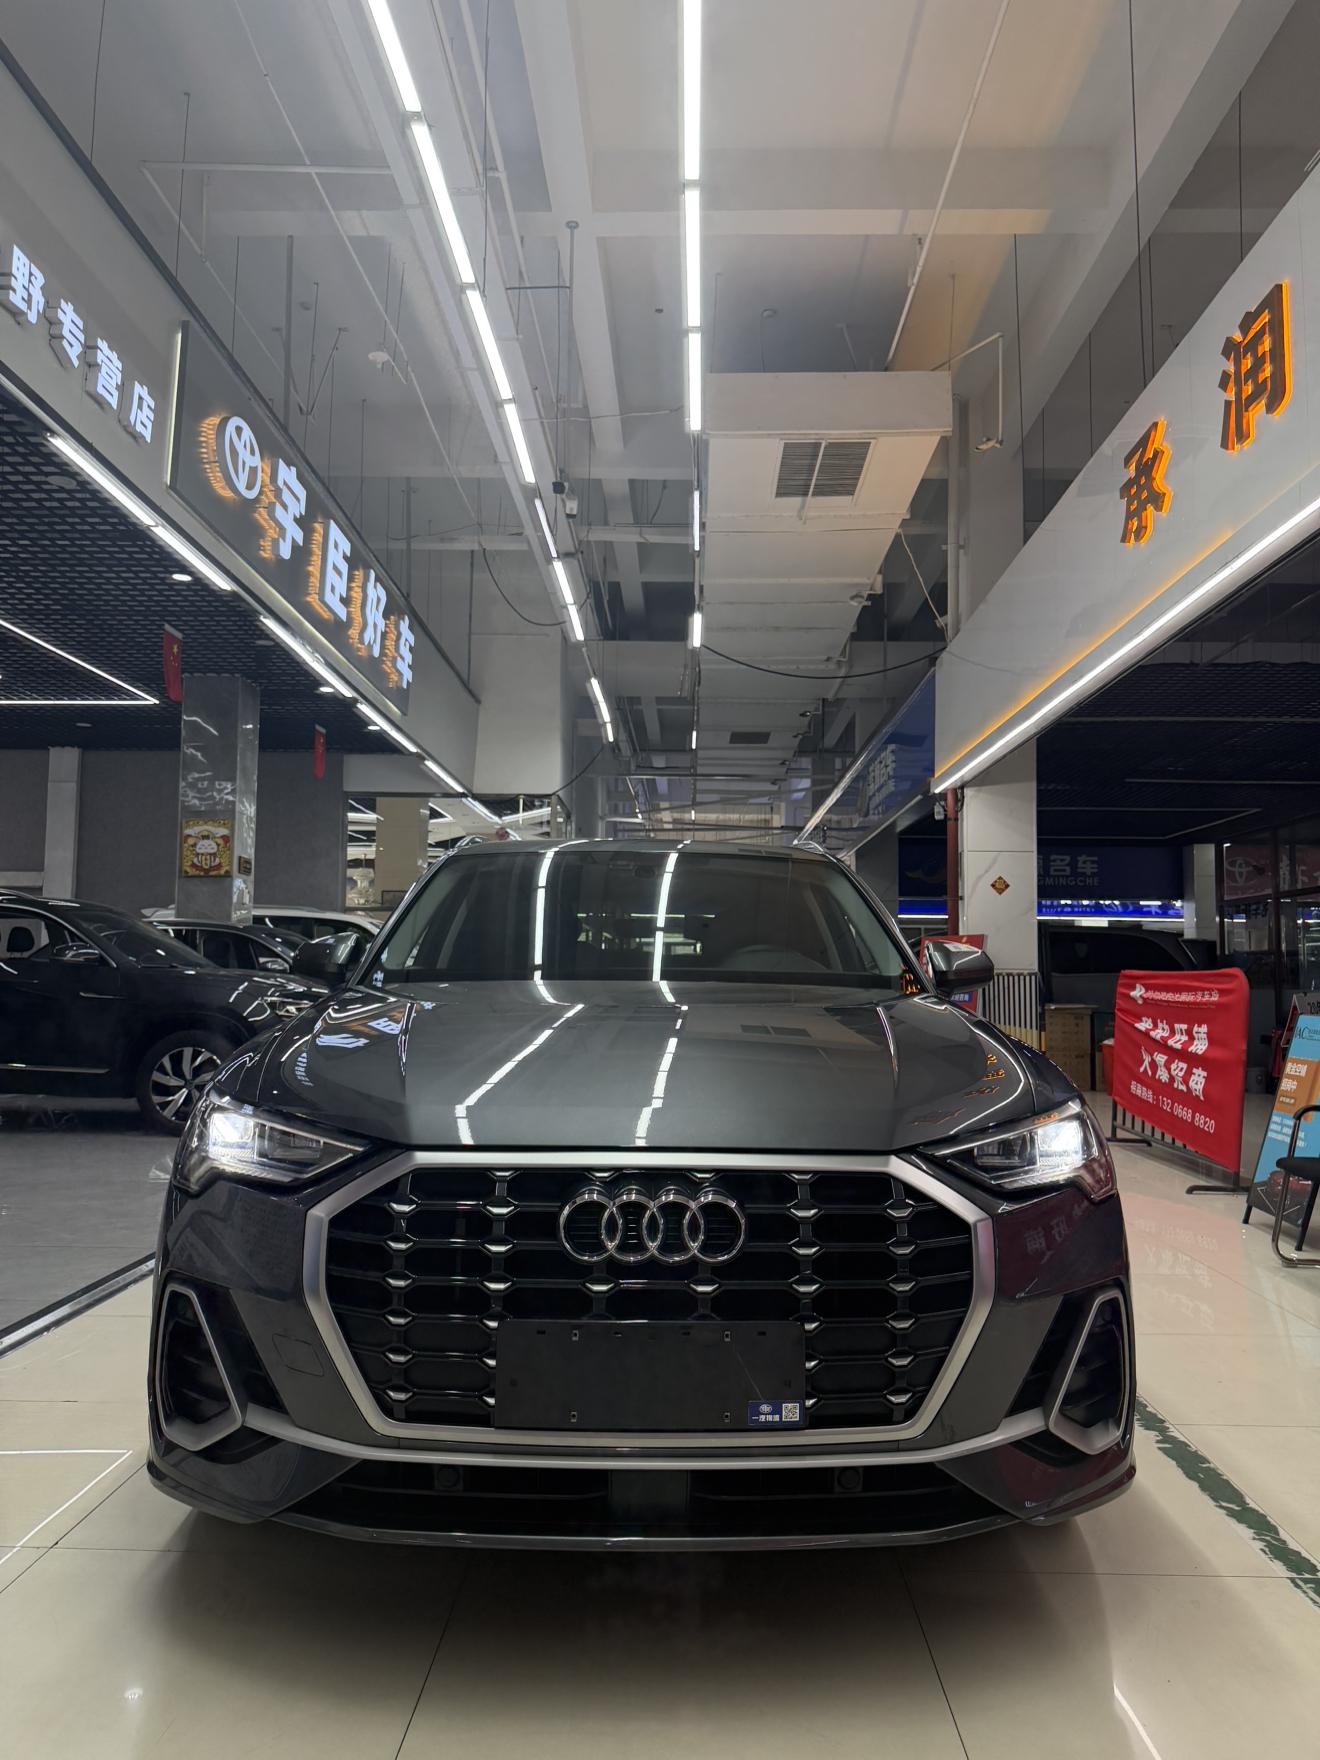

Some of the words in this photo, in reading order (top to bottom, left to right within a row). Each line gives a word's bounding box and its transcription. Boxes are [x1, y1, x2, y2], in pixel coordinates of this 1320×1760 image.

[9, 244, 155, 444] 野专营店
[274, 458, 415, 690] 宇臣好车
[1140, 1046, 1208, 1102] 火爆招商
[1159, 1095, 1172, 1113] 132
[1173, 1102, 1192, 1122] 0668
[1194, 1112, 1215, 1134] 8820
